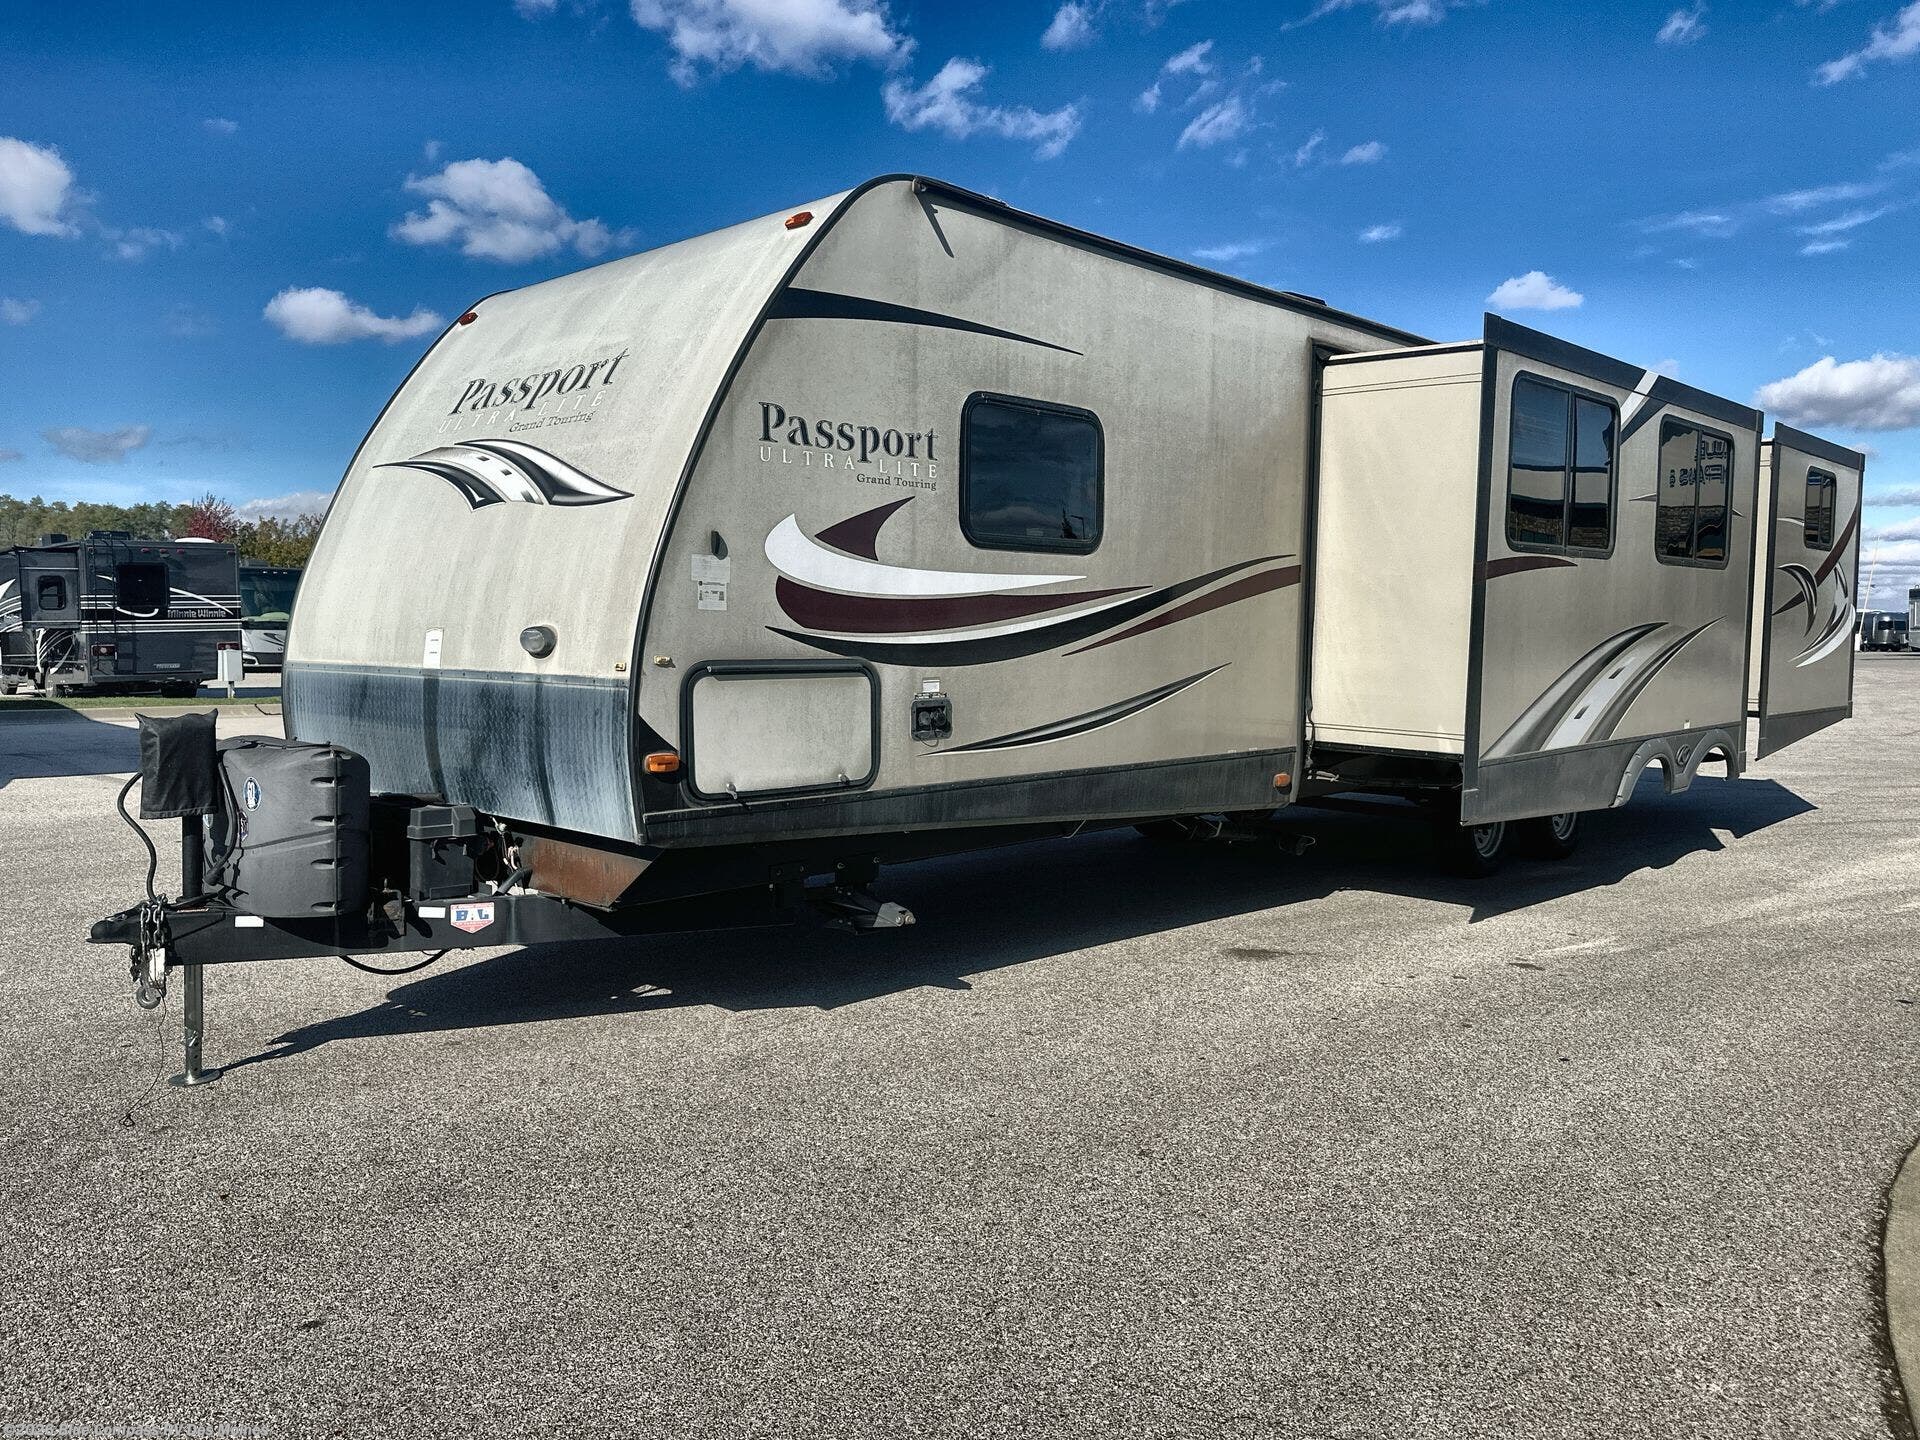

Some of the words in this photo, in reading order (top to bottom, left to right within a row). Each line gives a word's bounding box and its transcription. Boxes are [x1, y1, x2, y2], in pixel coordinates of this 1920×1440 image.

[447, 348, 630, 417] Passport
[439, 408, 515, 434] ULTRA
[538, 390, 606, 416] LITE
[508, 415, 548, 433] Grand
[549, 411, 594, 427] Touring
[758, 401, 939, 463] Passport
[760, 446, 855, 470] ULTRA
[879, 459, 938, 478] LITE
[856, 473, 891, 486] Grand
[893, 476, 937, 491] Touring
[167, 609, 197, 618] Minnie
[197, 609, 226, 618] Winnie
